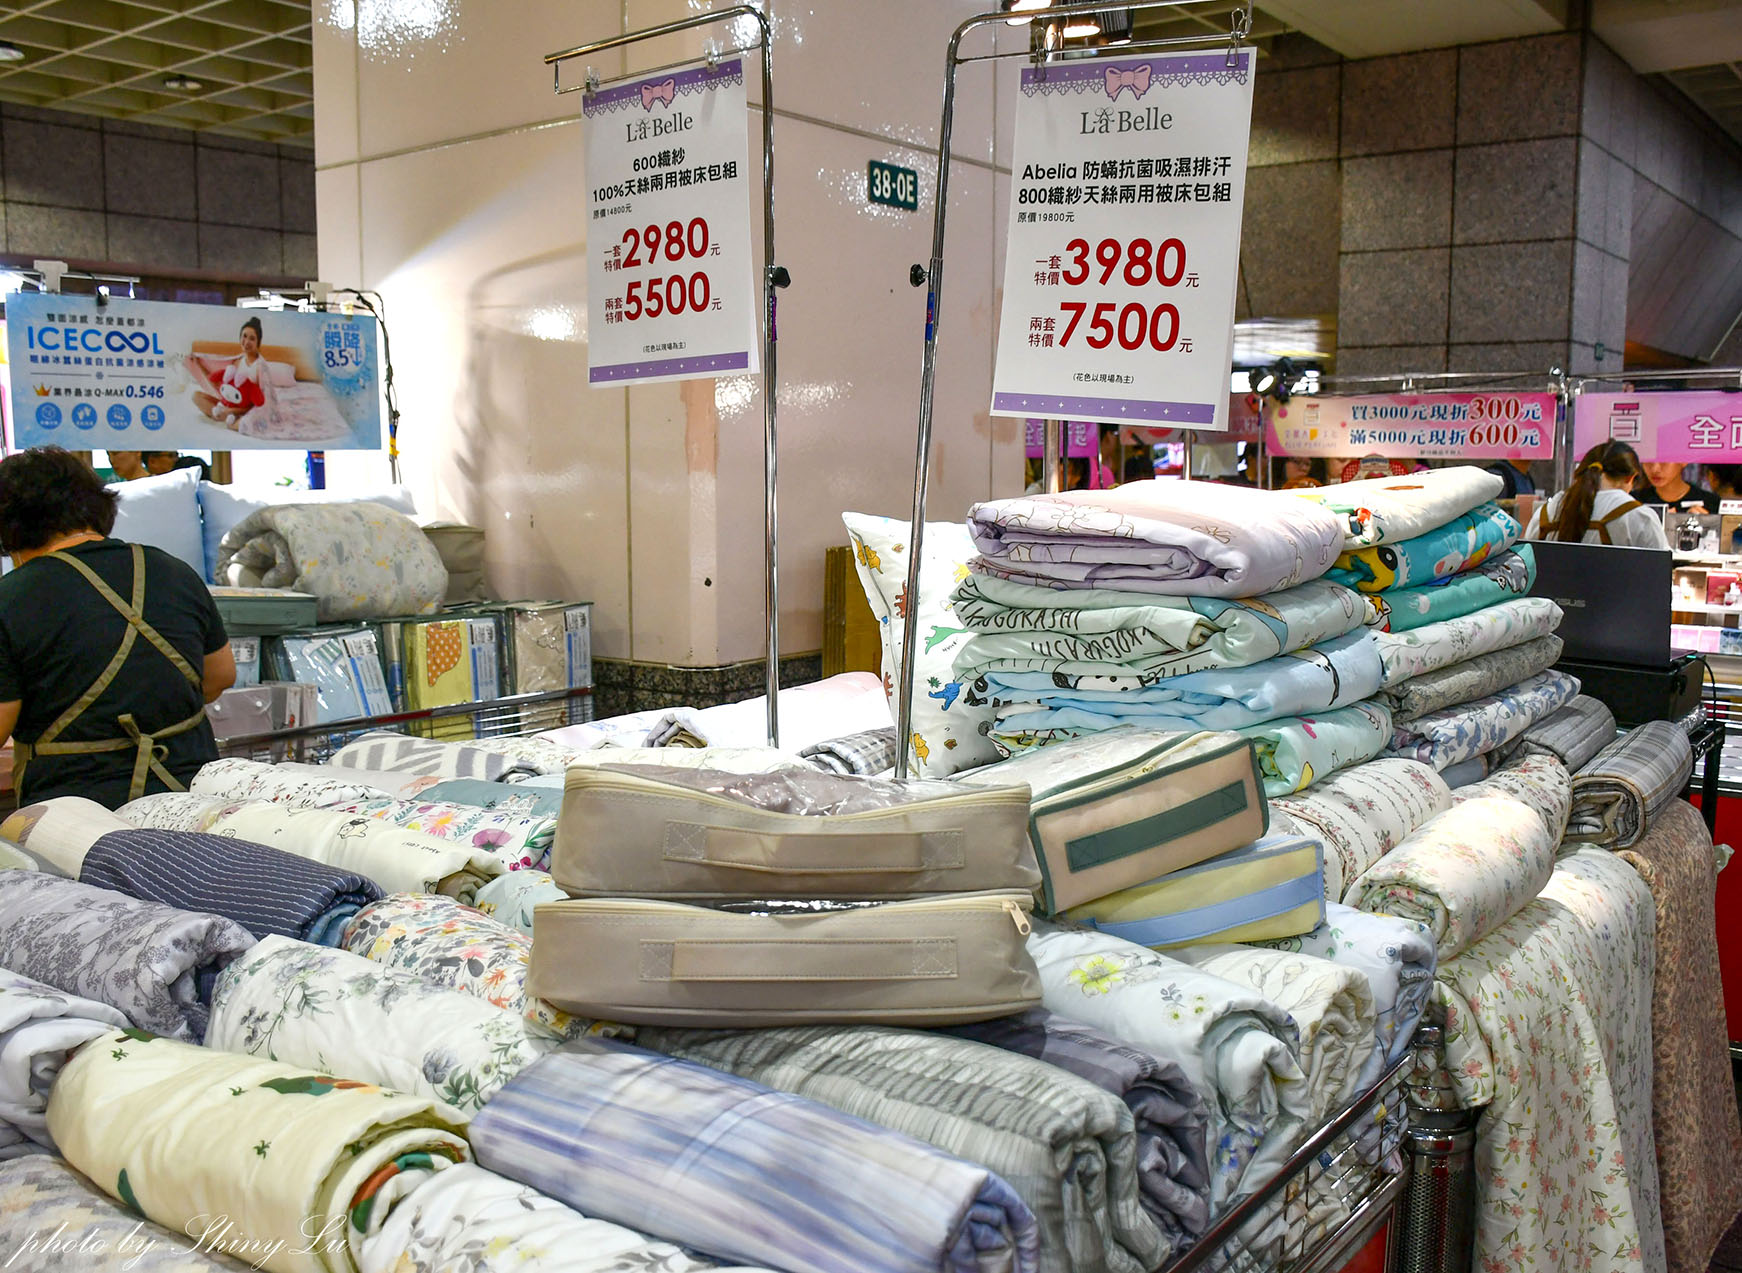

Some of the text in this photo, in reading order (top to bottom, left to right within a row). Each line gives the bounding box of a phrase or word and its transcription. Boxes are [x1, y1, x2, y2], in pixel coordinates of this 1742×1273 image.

[652, 112, 693, 137] Belle
[1117, 107, 1173, 132] Belle
[633, 147, 685, 171] 600織紗
[1022, 156, 1231, 180] Abelia 防蟎抗菌吸濕排汗
[593, 161, 737, 202] 100%天絲兩用被床包組
[1018, 182, 1231, 205] 800織紗天絲兩用被床包組
[593, 204, 632, 219] 原價14800元
[1017, 211, 1075, 223] 原價19800元
[1072, 372, 1136, 385] (花色以現場為主)
